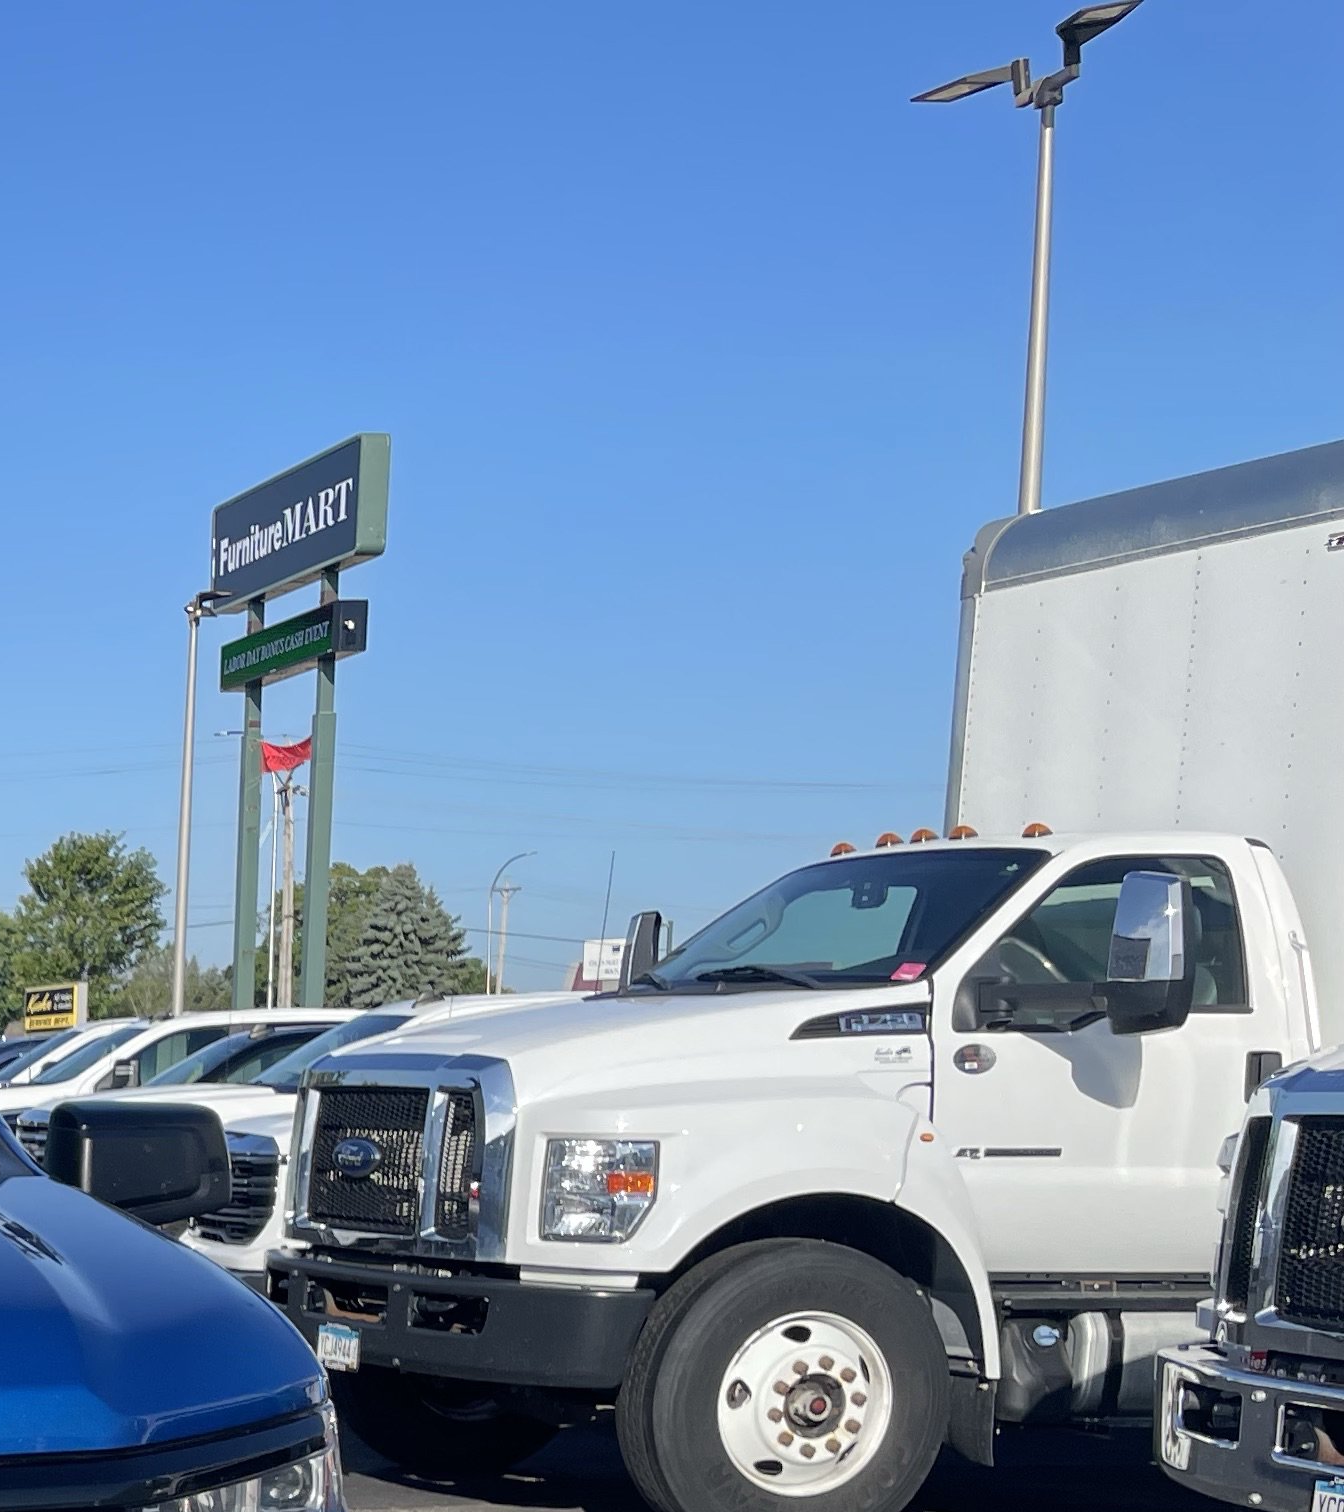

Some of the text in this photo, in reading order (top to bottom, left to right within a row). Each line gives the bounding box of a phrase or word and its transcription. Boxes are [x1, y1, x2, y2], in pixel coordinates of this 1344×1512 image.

[219, 477, 354, 577] FurnitureMART
[223, 620, 330, 675] LABOR DAY BONUS CASH EVENT
